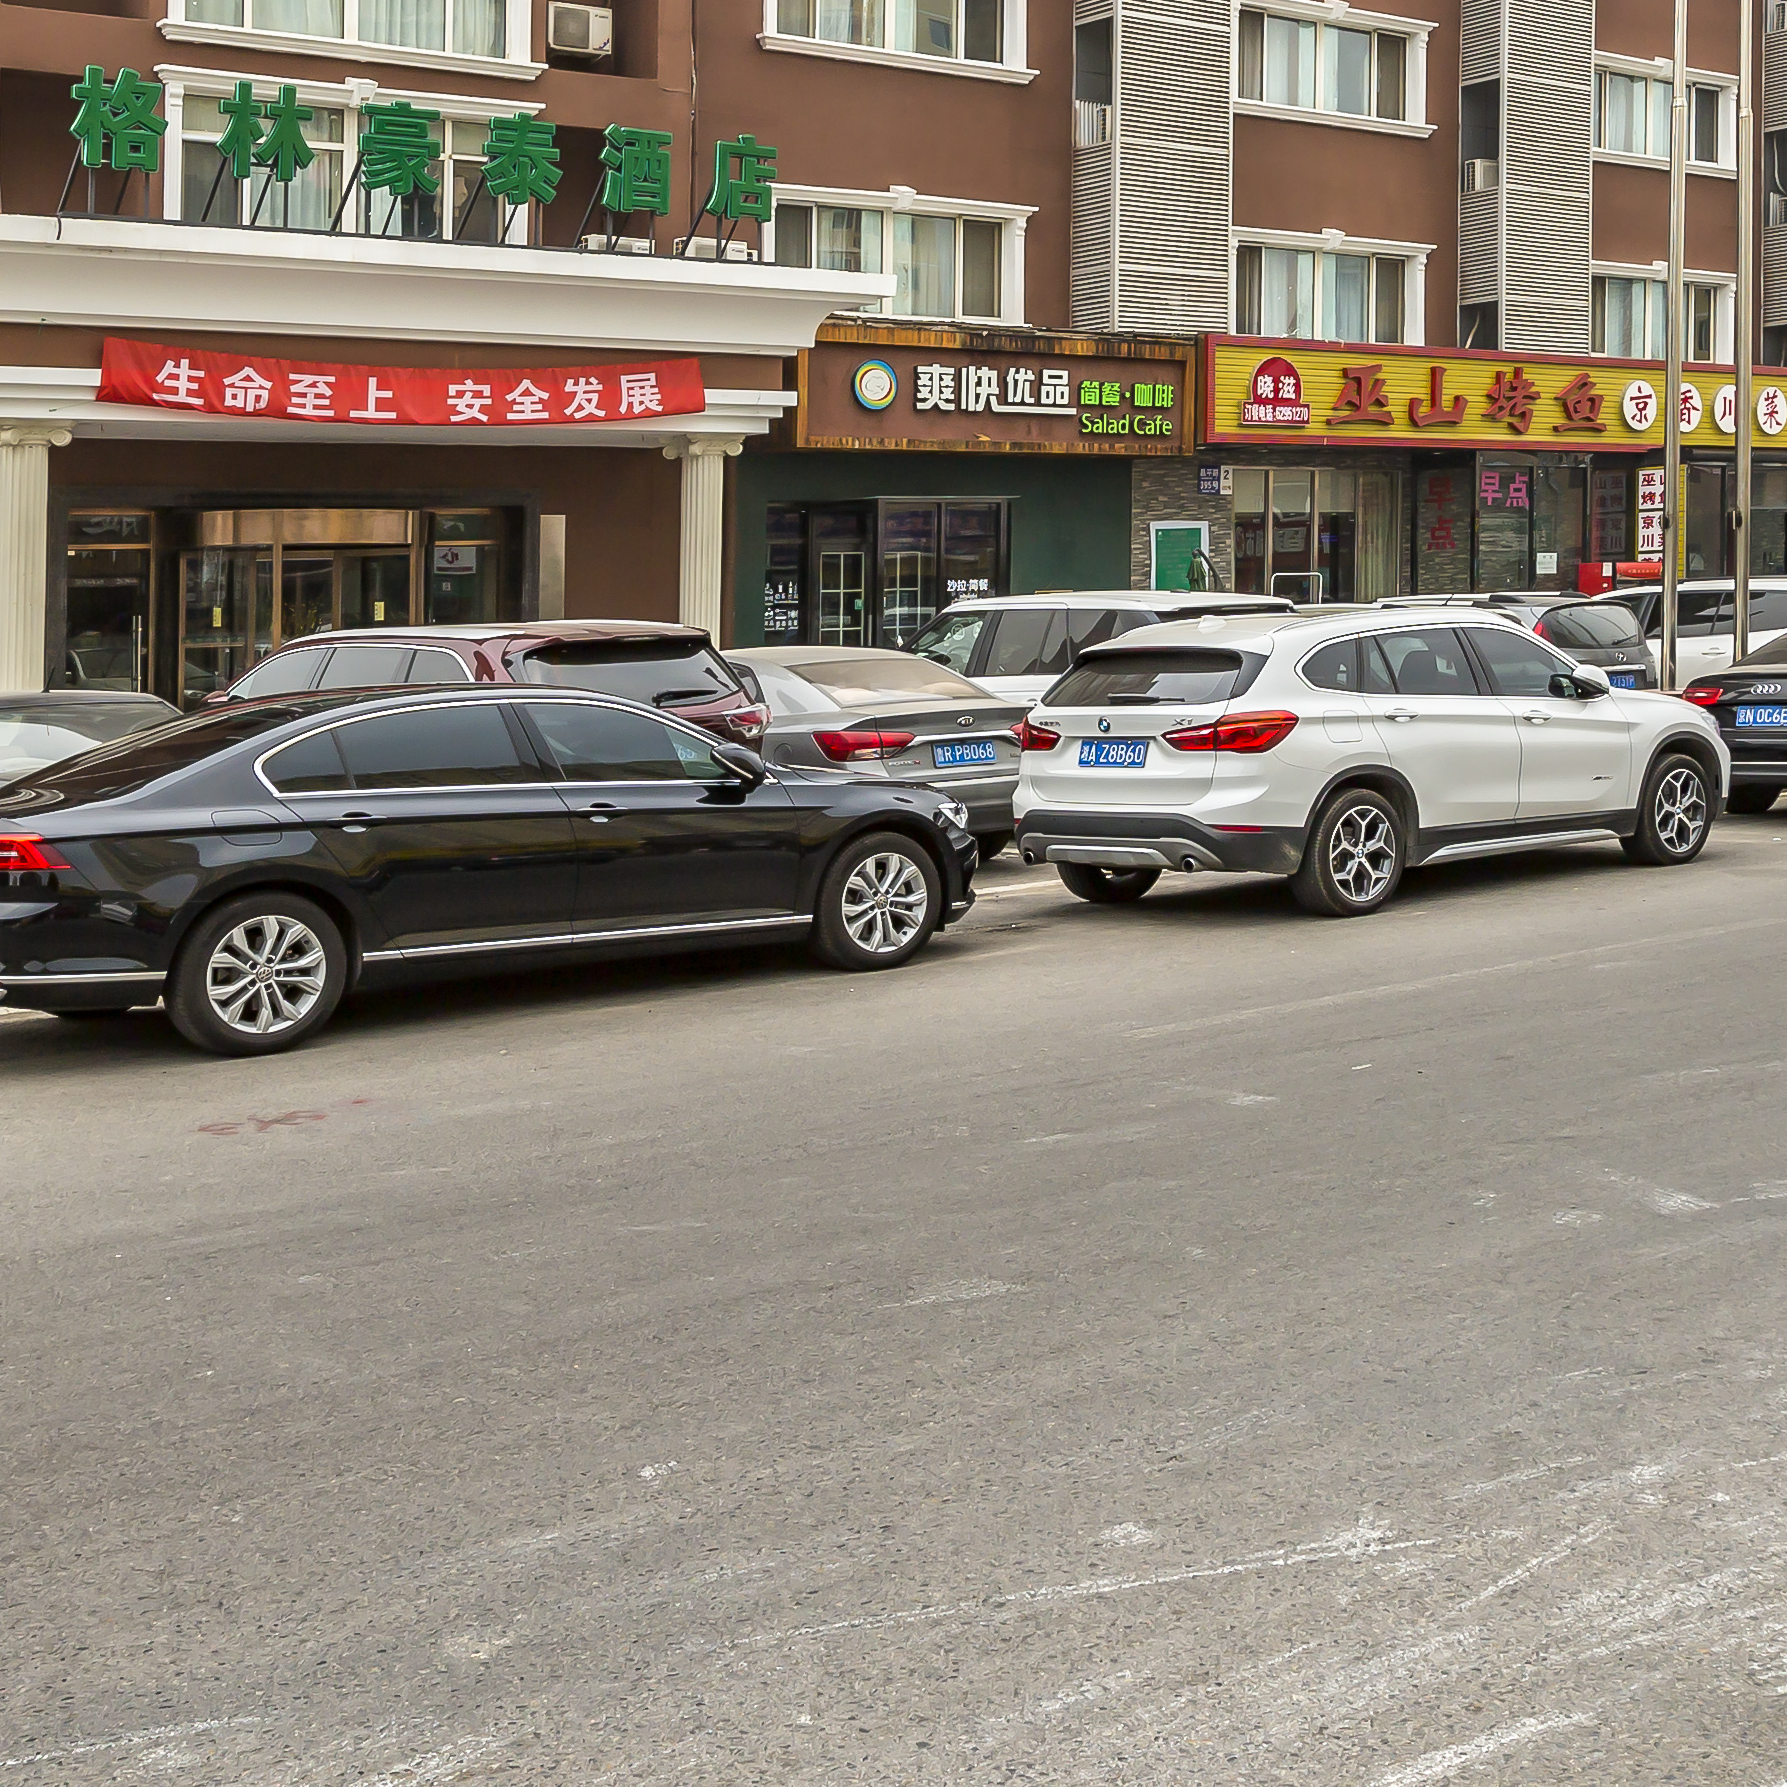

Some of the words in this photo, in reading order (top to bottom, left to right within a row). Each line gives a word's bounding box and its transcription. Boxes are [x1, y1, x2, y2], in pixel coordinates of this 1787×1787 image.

[69, 64, 779, 224] 格林豪泰酒店
[153, 358, 397, 420] 生命至上
[447, 373, 664, 422] 安全发展
[915, 364, 1075, 415] 爽快优品
[1257, 375, 1296, 399] 晓滋
[1326, 364, 1608, 434] 巫山烤鱼
[1080, 413, 1129, 435] Salad
[1133, 414, 1173, 436] Cafe
[1424, 476, 1456, 551] 早点
[1480, 471, 1530, 507] 早点
[1171, 718, 1193, 726] X1
